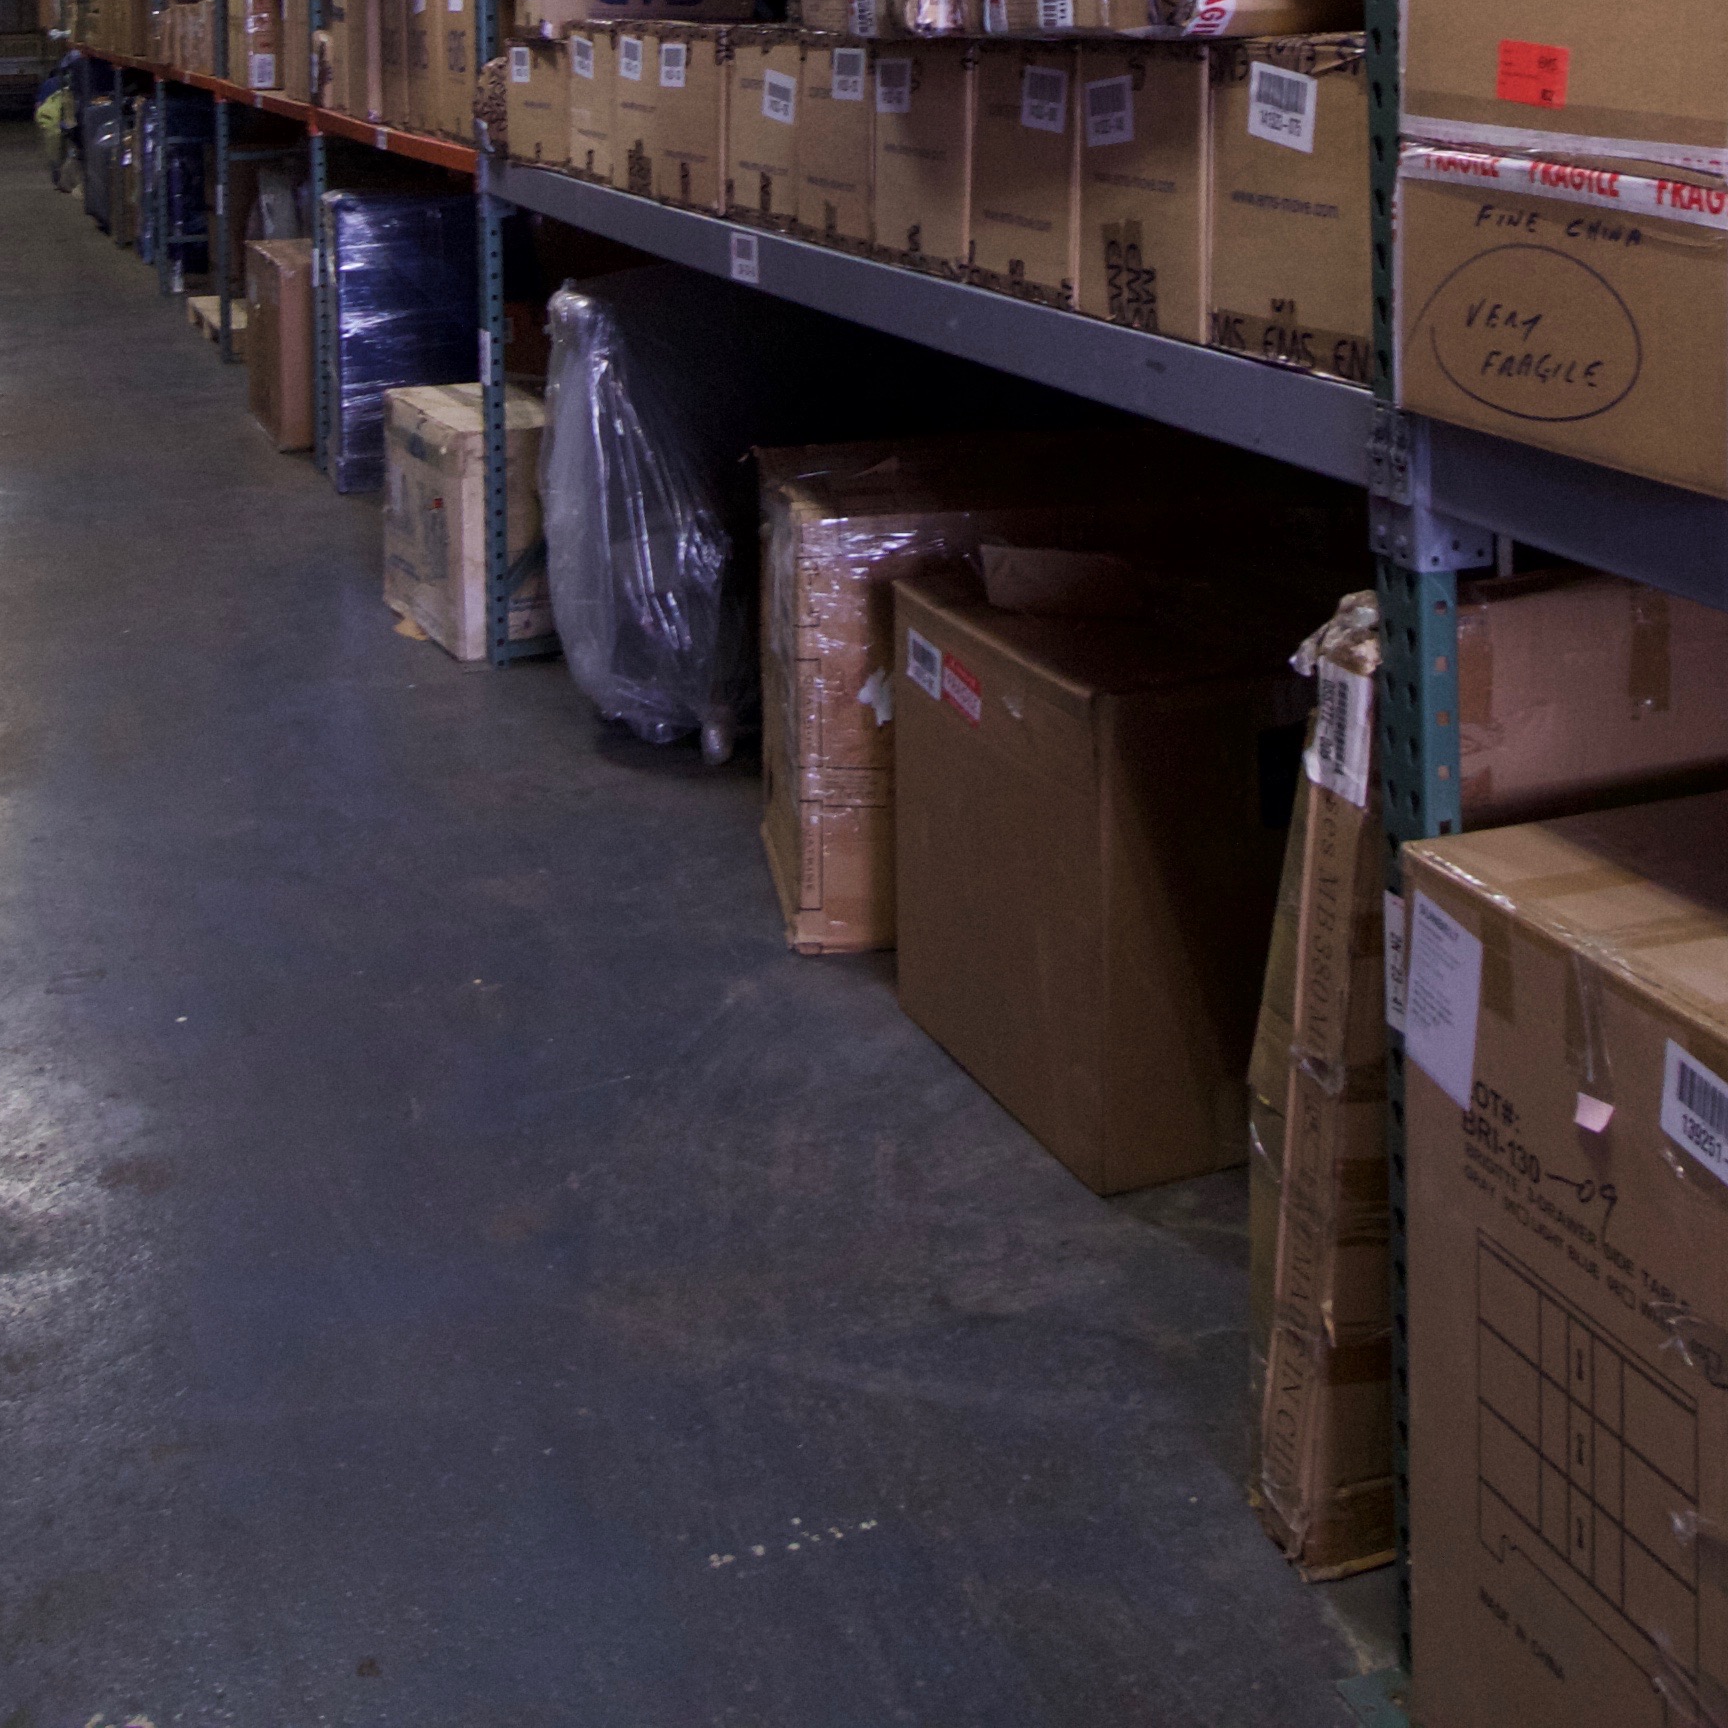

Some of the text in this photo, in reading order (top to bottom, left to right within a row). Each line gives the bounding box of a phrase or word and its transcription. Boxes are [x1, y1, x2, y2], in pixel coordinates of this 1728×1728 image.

[1526, 160, 1621, 198] FRAGILE
[1474, 203, 1645, 248] FINE CHINA
[1463, 296, 1544, 340] VERY
[1479, 349, 1606, 388] FRAGILE
[1472, 1079, 1521, 1134] OT#:
[1461, 1109, 1541, 1184] BRI-130
